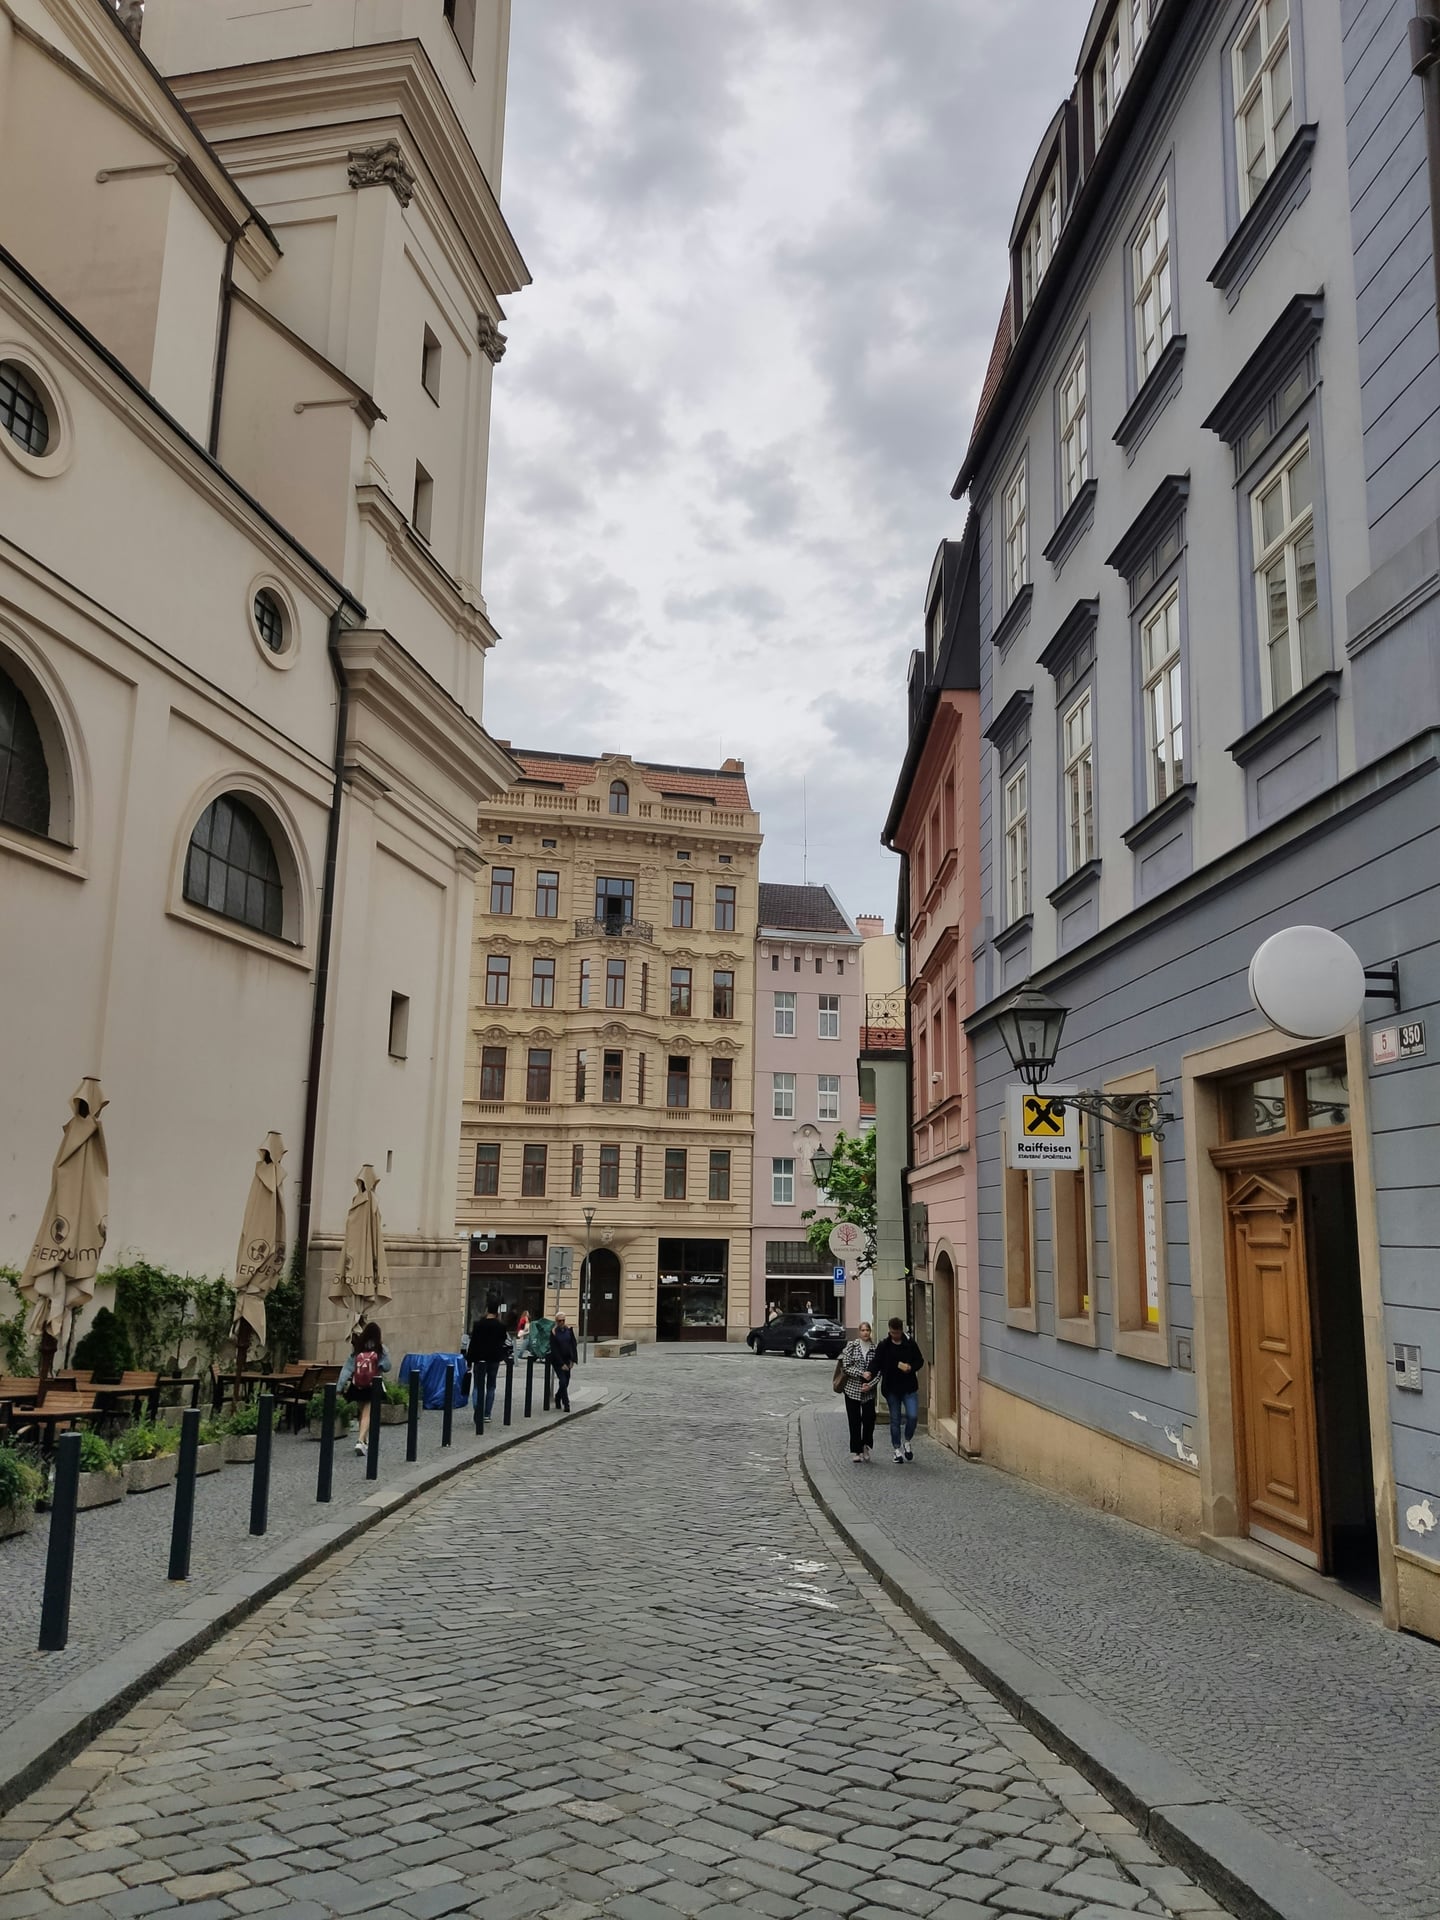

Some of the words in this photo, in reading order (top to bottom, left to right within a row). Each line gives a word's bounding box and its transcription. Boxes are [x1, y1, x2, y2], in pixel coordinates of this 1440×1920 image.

[1381, 1033, 1387, 1050] 5
[1402, 1025, 1421, 1045] 350
[1017, 1142, 1072, 1153] Raiffeisen
[836, 1268, 843, 1279] P
